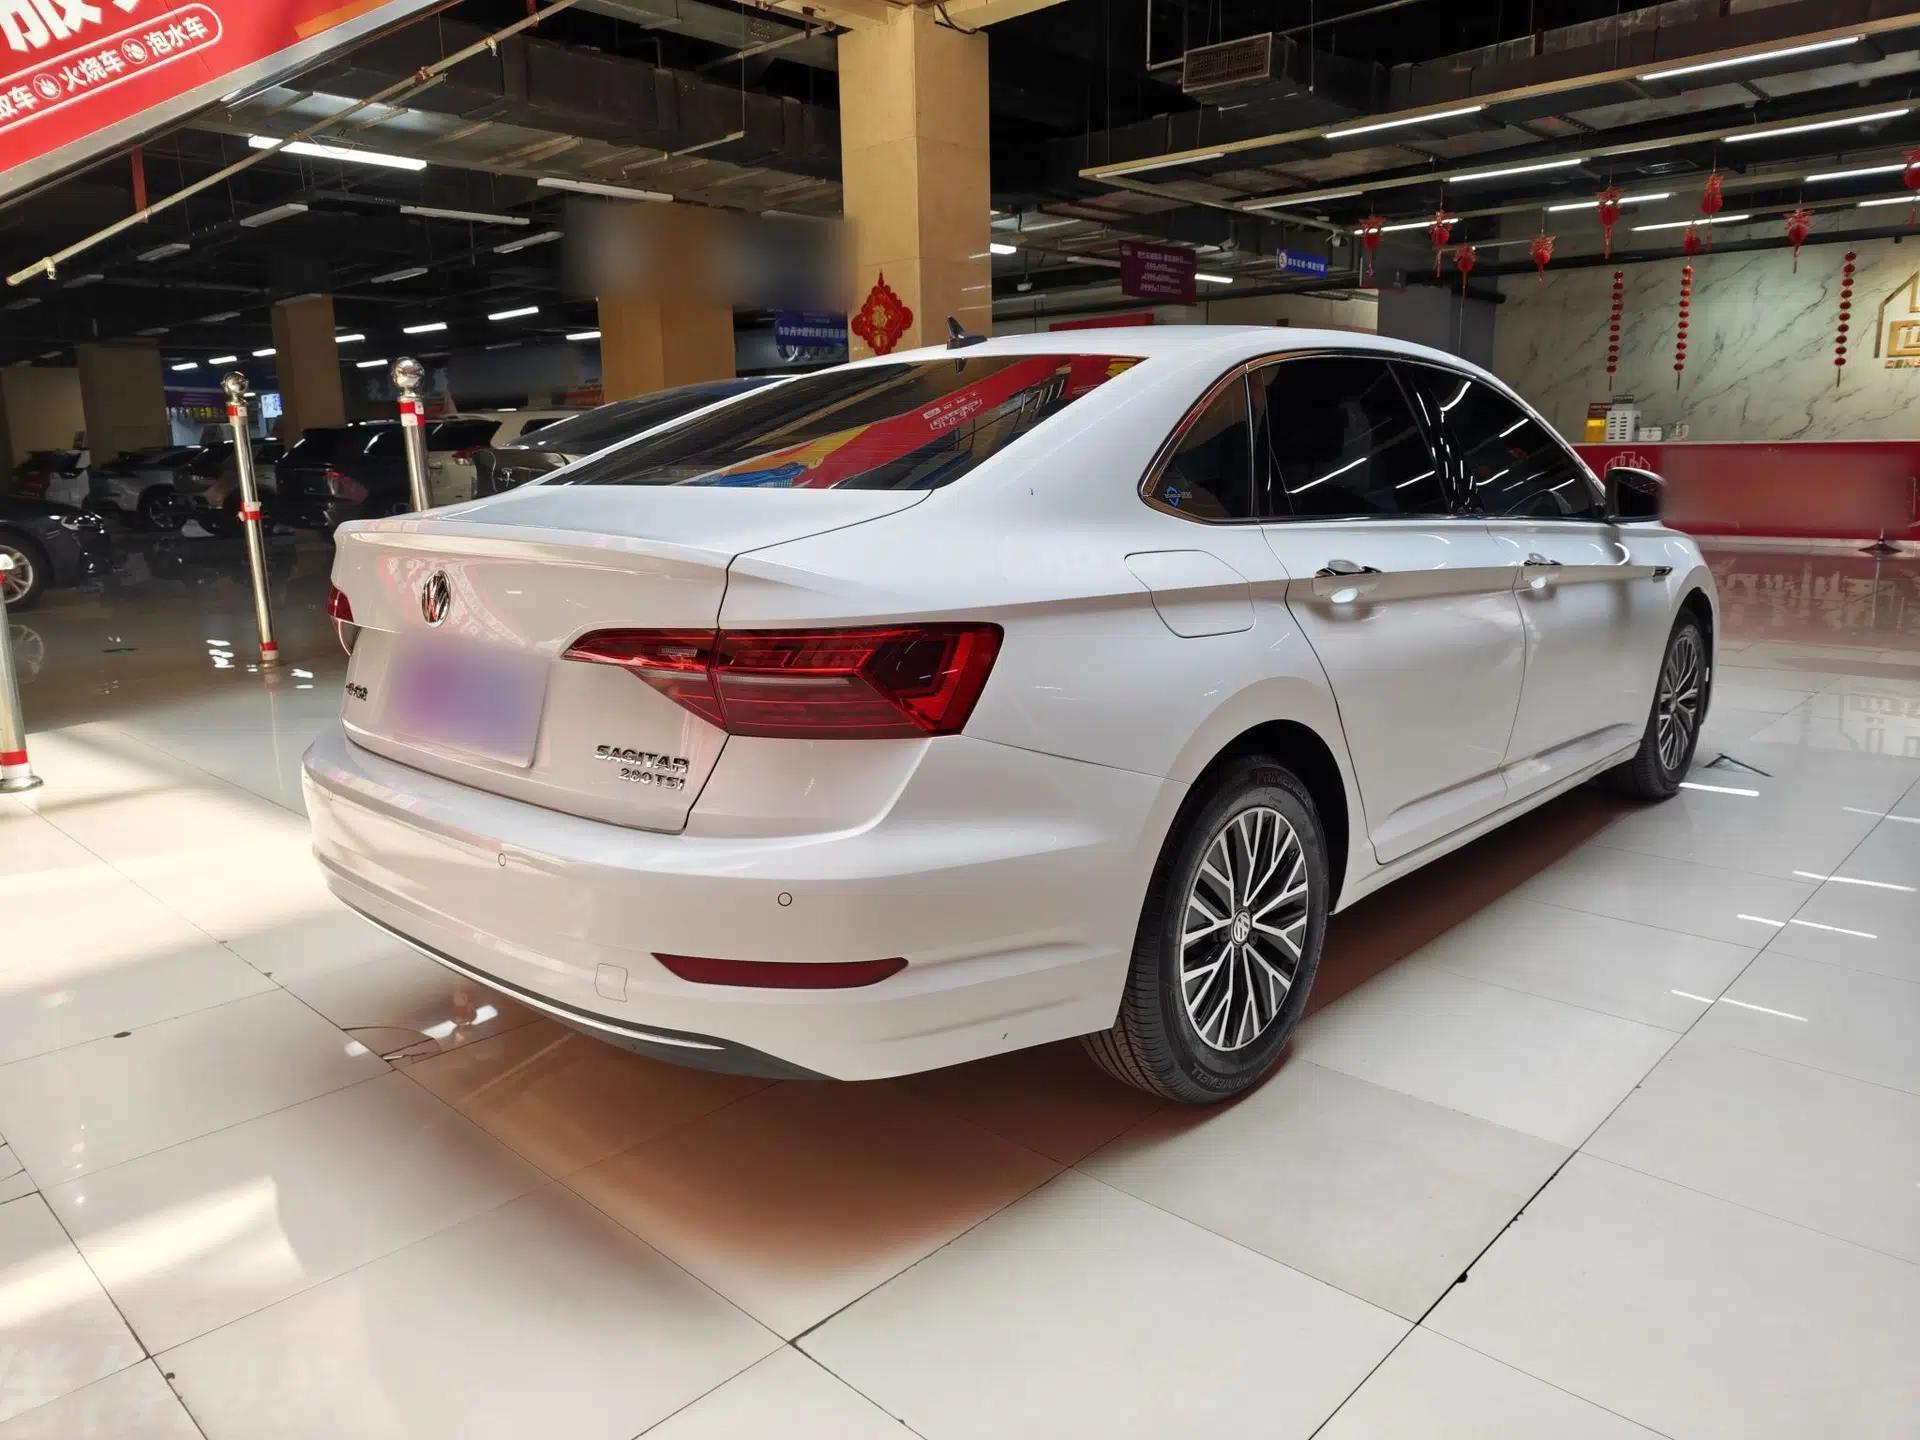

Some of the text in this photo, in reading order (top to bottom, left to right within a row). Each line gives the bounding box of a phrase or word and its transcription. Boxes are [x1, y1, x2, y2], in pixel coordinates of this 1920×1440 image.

[59, 49, 126, 92] 火烧车
[144, 15, 209, 57] 泡水车
[594, 744, 690, 774] SAGITAR
